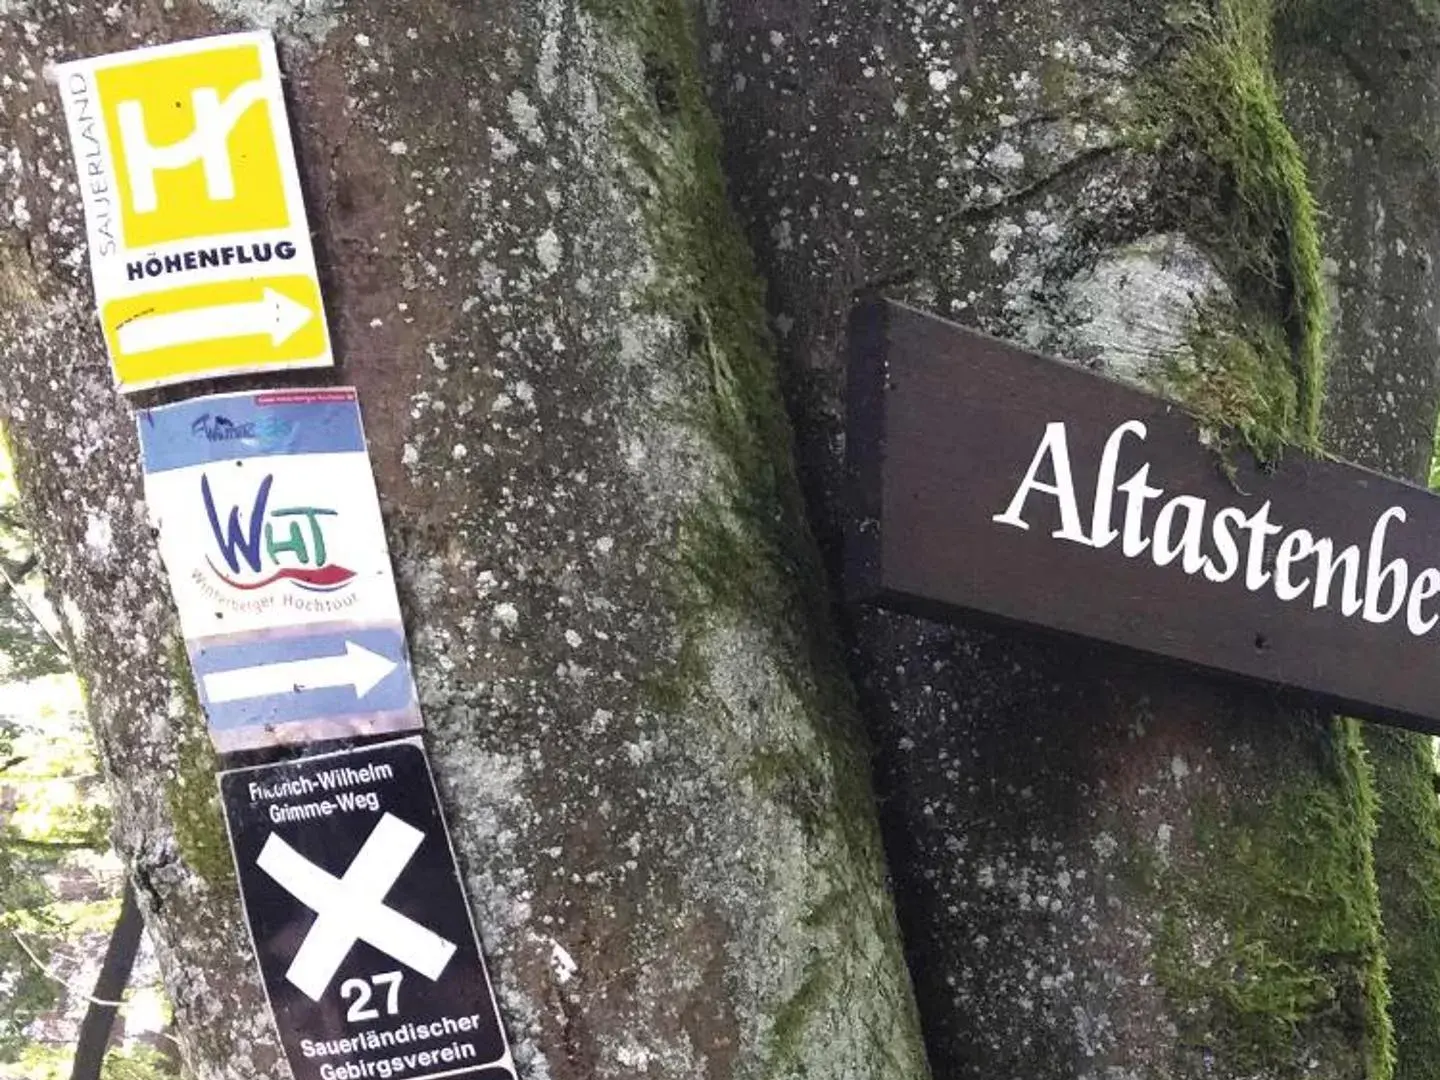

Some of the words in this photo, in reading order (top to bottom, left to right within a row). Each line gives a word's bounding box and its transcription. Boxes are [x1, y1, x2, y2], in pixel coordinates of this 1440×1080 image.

[69, 72, 116, 257] SAUERLAND
[127, 240, 297, 281] HÖHENFLUG
[201, 472, 338, 574] WHT
[283, 592, 358, 613] Hochtour
[269, 791, 380, 824] Grimme-Weg
[340, 971, 404, 1023] 27
[301, 1012, 481, 1059] Sauerländischer
